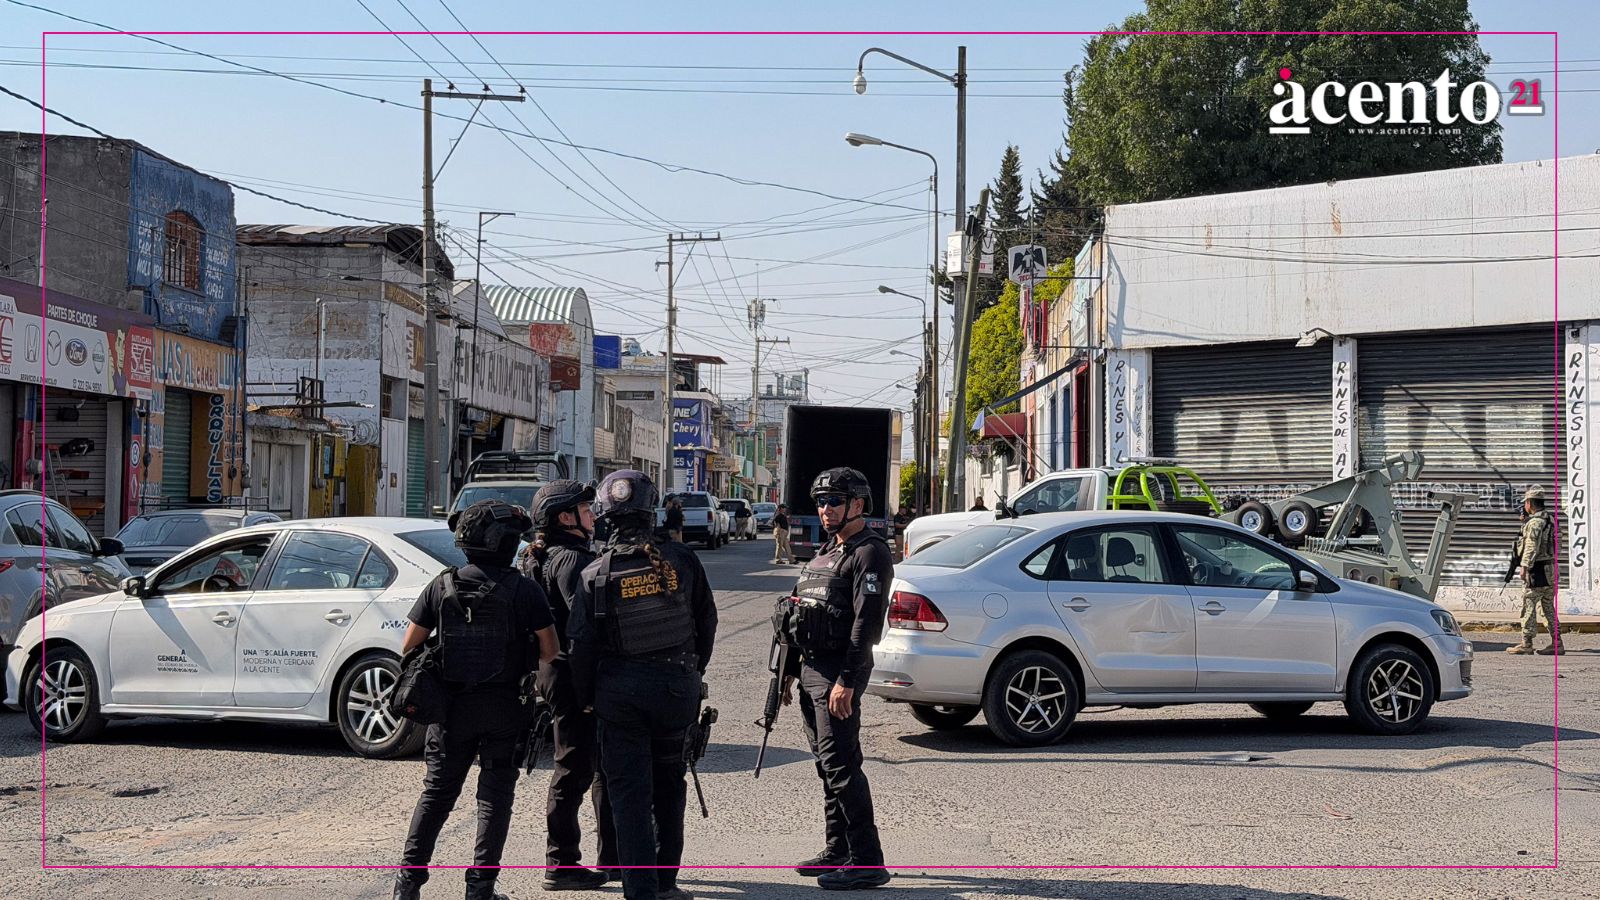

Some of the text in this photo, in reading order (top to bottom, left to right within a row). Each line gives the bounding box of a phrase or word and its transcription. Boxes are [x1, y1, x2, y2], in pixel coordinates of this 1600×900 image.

[47, 303, 98, 328] PARTES DE CHOQUE
[672, 421, 700, 437] Chevy
[621, 580, 679, 599] ESPECIAES
[157, 655, 188, 663] GENERAL
